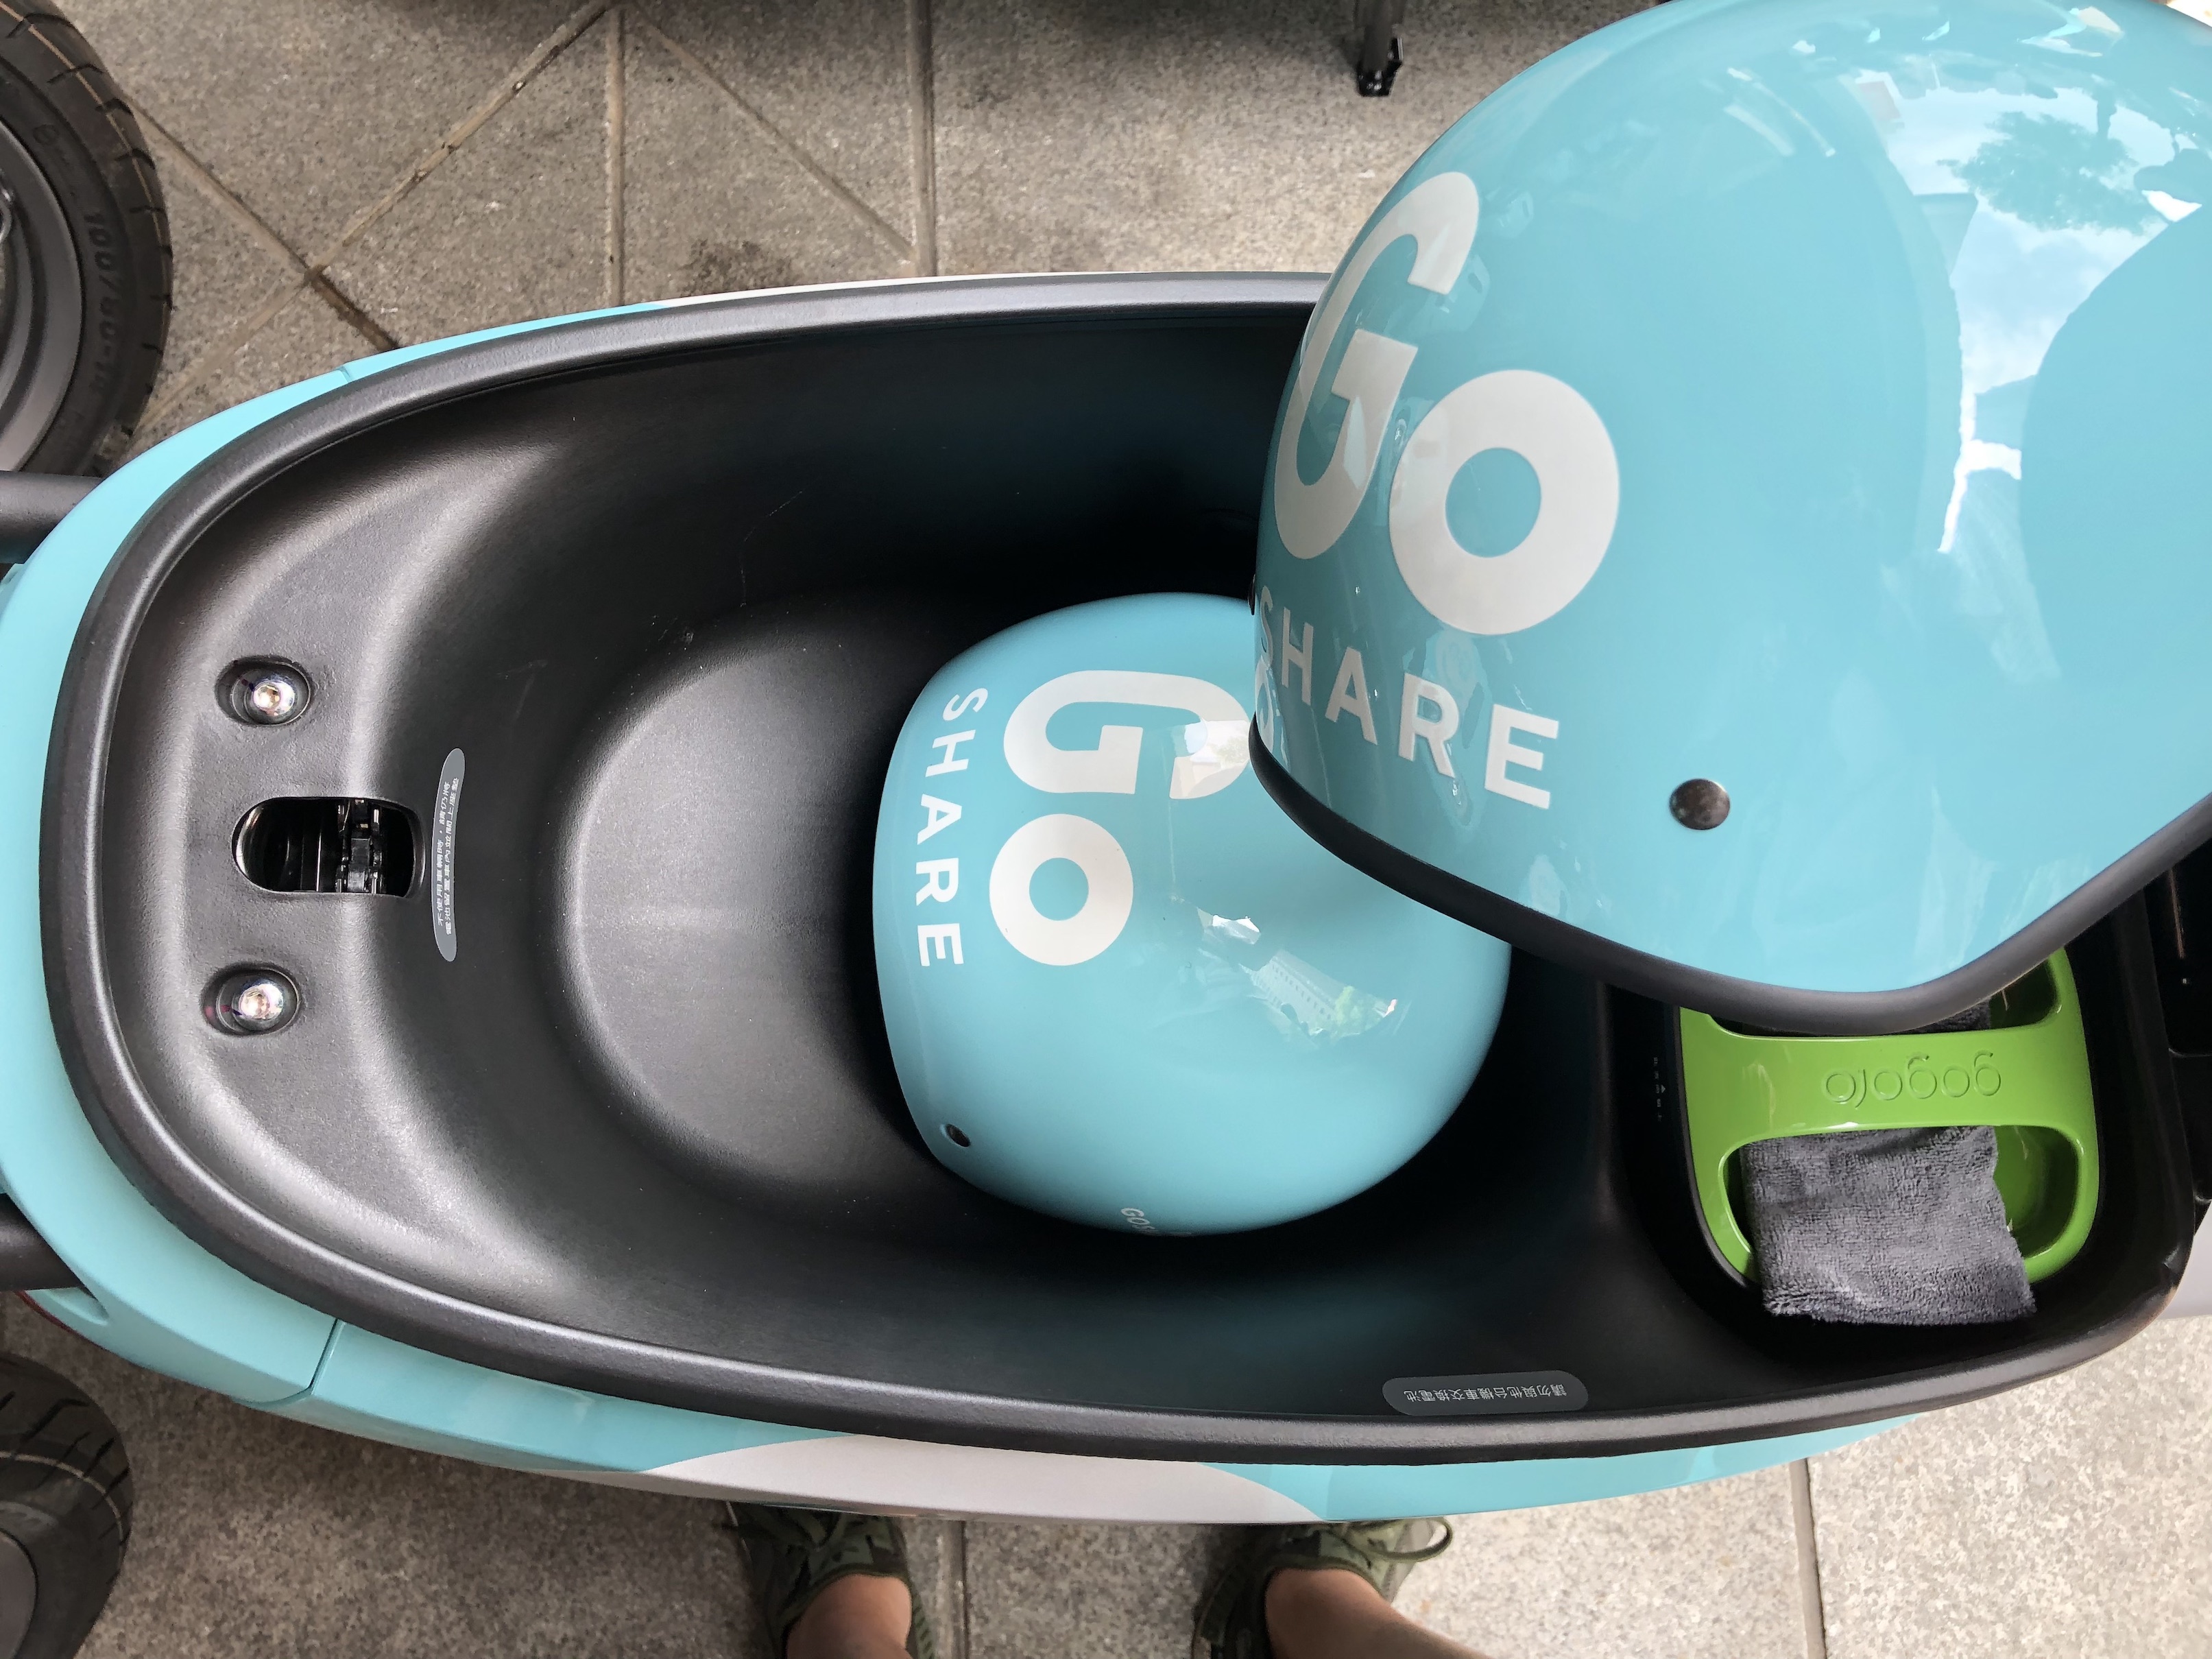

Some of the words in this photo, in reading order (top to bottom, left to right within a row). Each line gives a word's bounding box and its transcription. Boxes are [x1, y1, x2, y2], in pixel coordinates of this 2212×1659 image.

[1275, 171, 1620, 636] GO
[989, 669, 1251, 966] GO
[1260, 585, 1559, 809] SHARE
[915, 687, 988, 967] SHARE
[1822, 1050, 2001, 1110] gogoro
[1403, 1383, 1568, 1403] 請勿與他台機車交換電池
